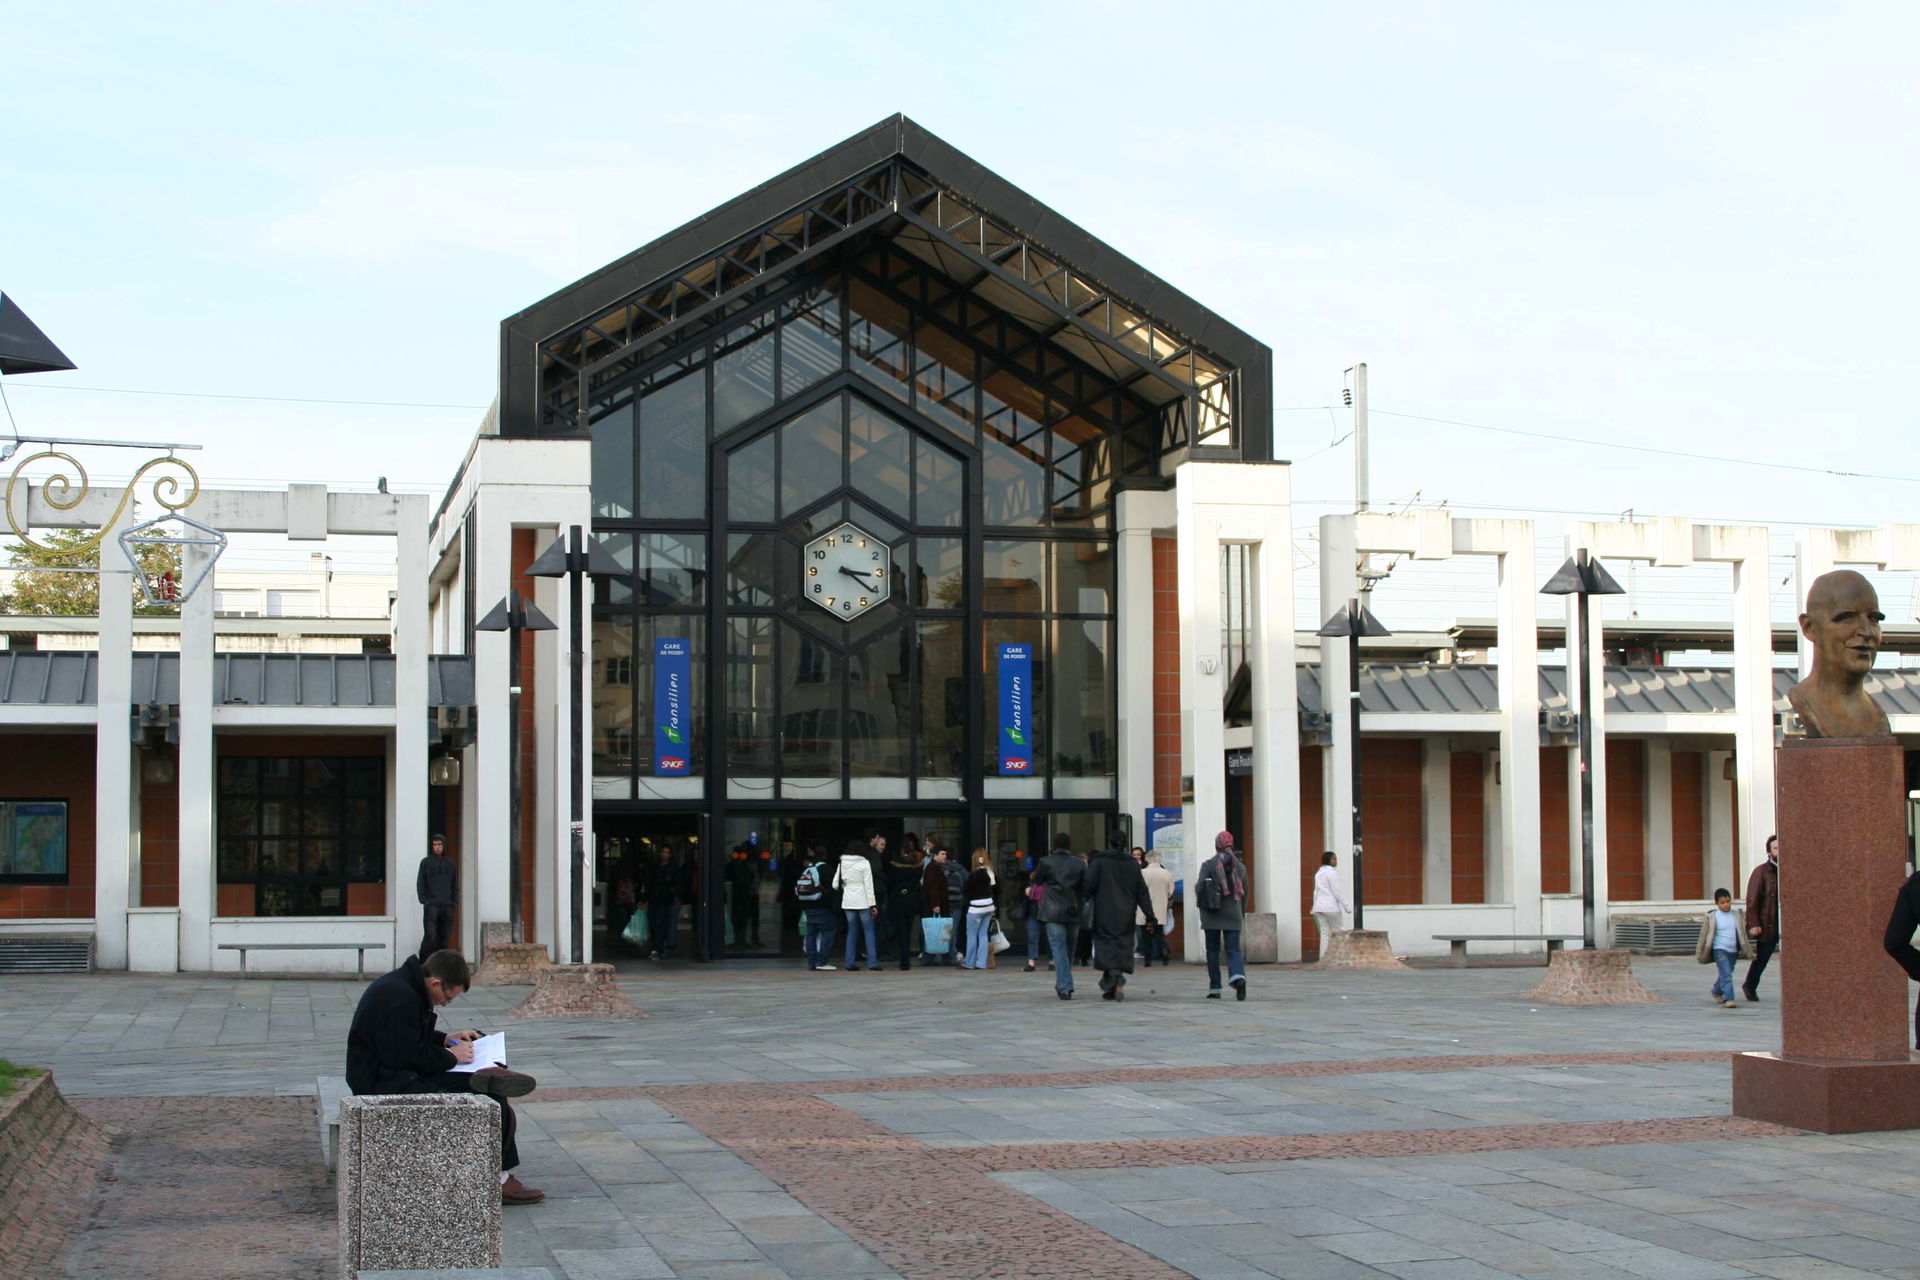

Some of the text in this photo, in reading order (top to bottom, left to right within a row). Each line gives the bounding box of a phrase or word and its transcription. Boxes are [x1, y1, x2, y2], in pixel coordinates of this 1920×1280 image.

[825, 538, 836, 548] 11
[841, 534, 853, 544] 12
[860, 539, 866, 548] 1
[813, 550, 826, 560] 10
[872, 551, 879, 560] 2
[809, 567, 818, 576] 9
[875, 568, 884, 578] 3
[814, 584, 822, 593] 8
[872, 585, 879, 594] 4
[828, 597, 836, 606] 7
[843, 601, 851, 611] 6
[860, 597, 868, 606] 5
[668, 673, 679, 738] Transilien
[1011, 676, 1022, 739] Transilien
[661, 760, 685, 769] SNCF
[1005, 761, 1028, 769] SNCF
